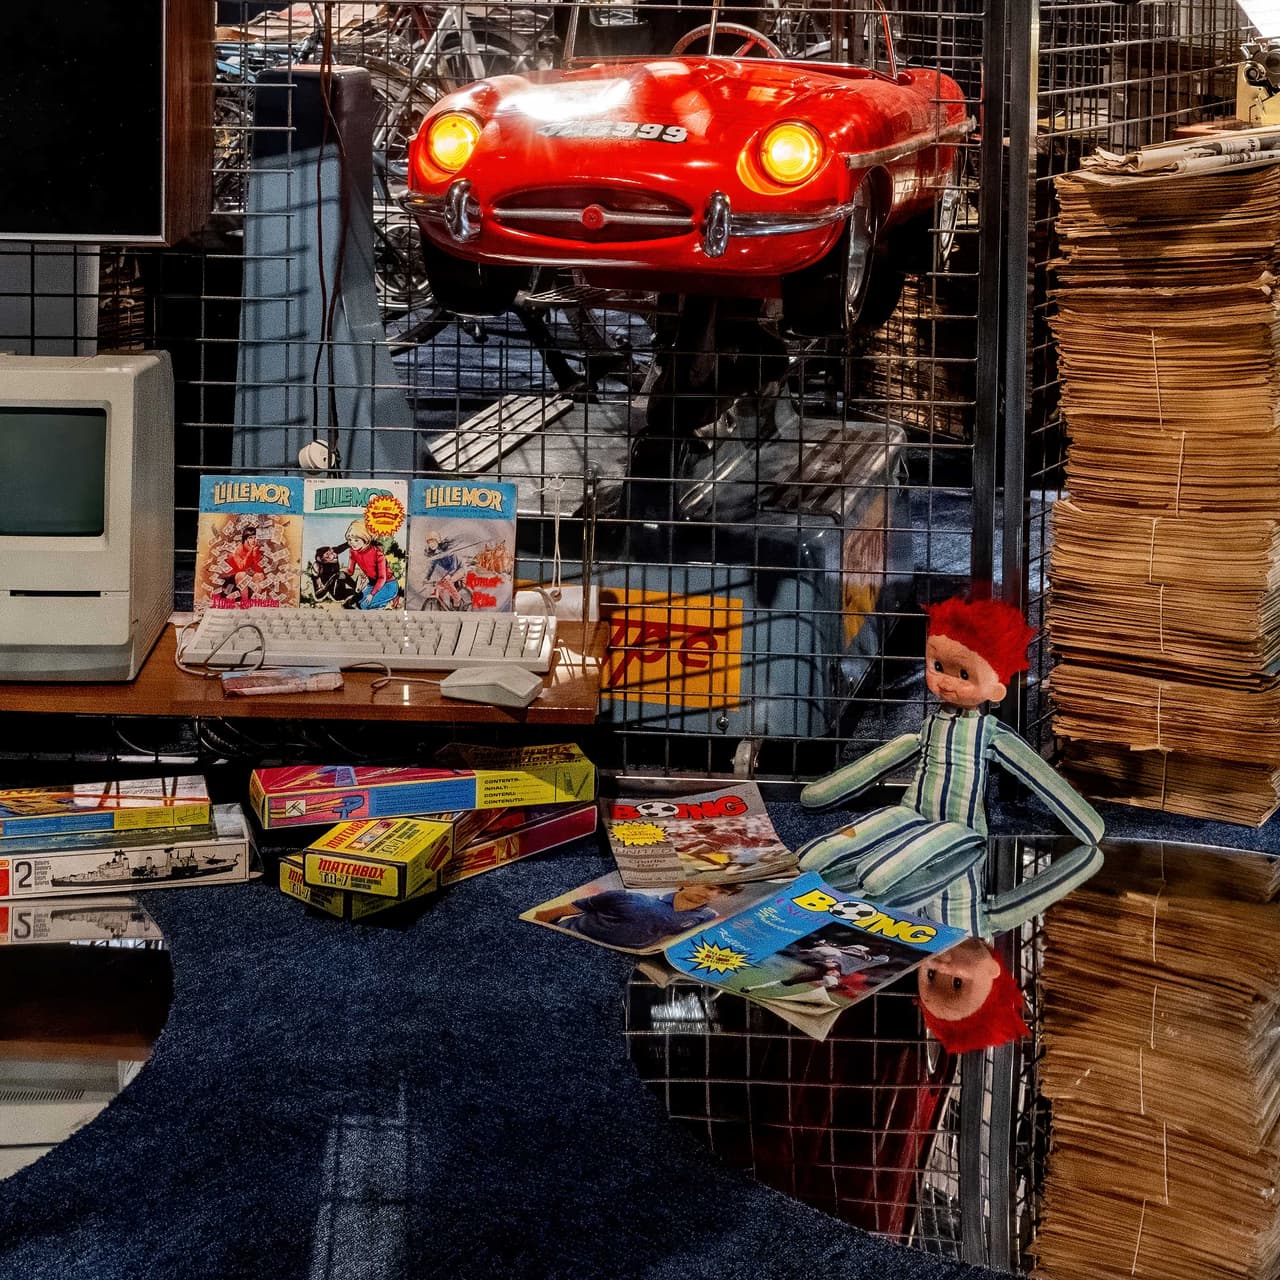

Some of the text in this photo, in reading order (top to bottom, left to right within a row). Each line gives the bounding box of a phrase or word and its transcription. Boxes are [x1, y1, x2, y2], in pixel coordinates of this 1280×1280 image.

[214, 482, 291, 507] LILLEMOR
[314, 484, 393, 511] LILLEMO
[425, 483, 503, 511] LILLEMOR
[14, 861, 32, 888] 2
[318, 857, 386, 880] MATCHBOX
